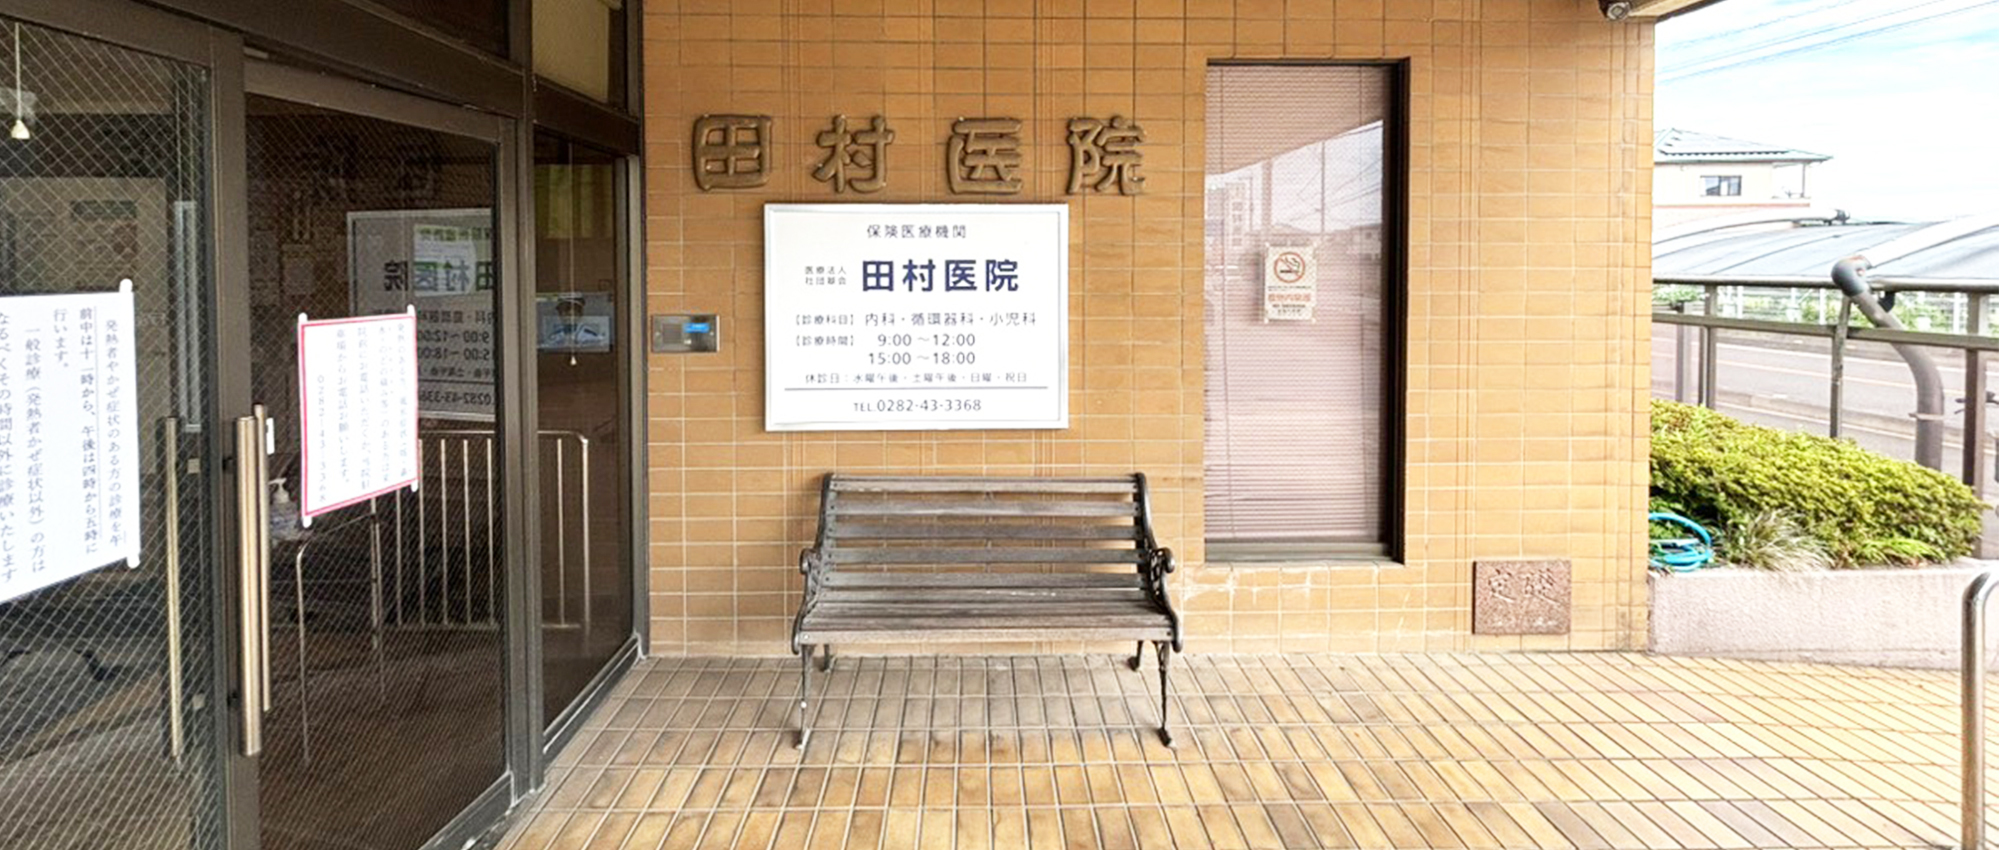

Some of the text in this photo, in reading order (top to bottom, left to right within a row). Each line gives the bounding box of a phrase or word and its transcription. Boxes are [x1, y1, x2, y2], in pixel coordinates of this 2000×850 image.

[693, 114, 1146, 194] 田村医院
[866, 224, 967, 240] 保険医療機関
[861, 258, 1020, 293] 田村医院
[864, 312, 1037, 327] 内科・循環器科・小児科
[53, 308, 70, 368] 行います。
